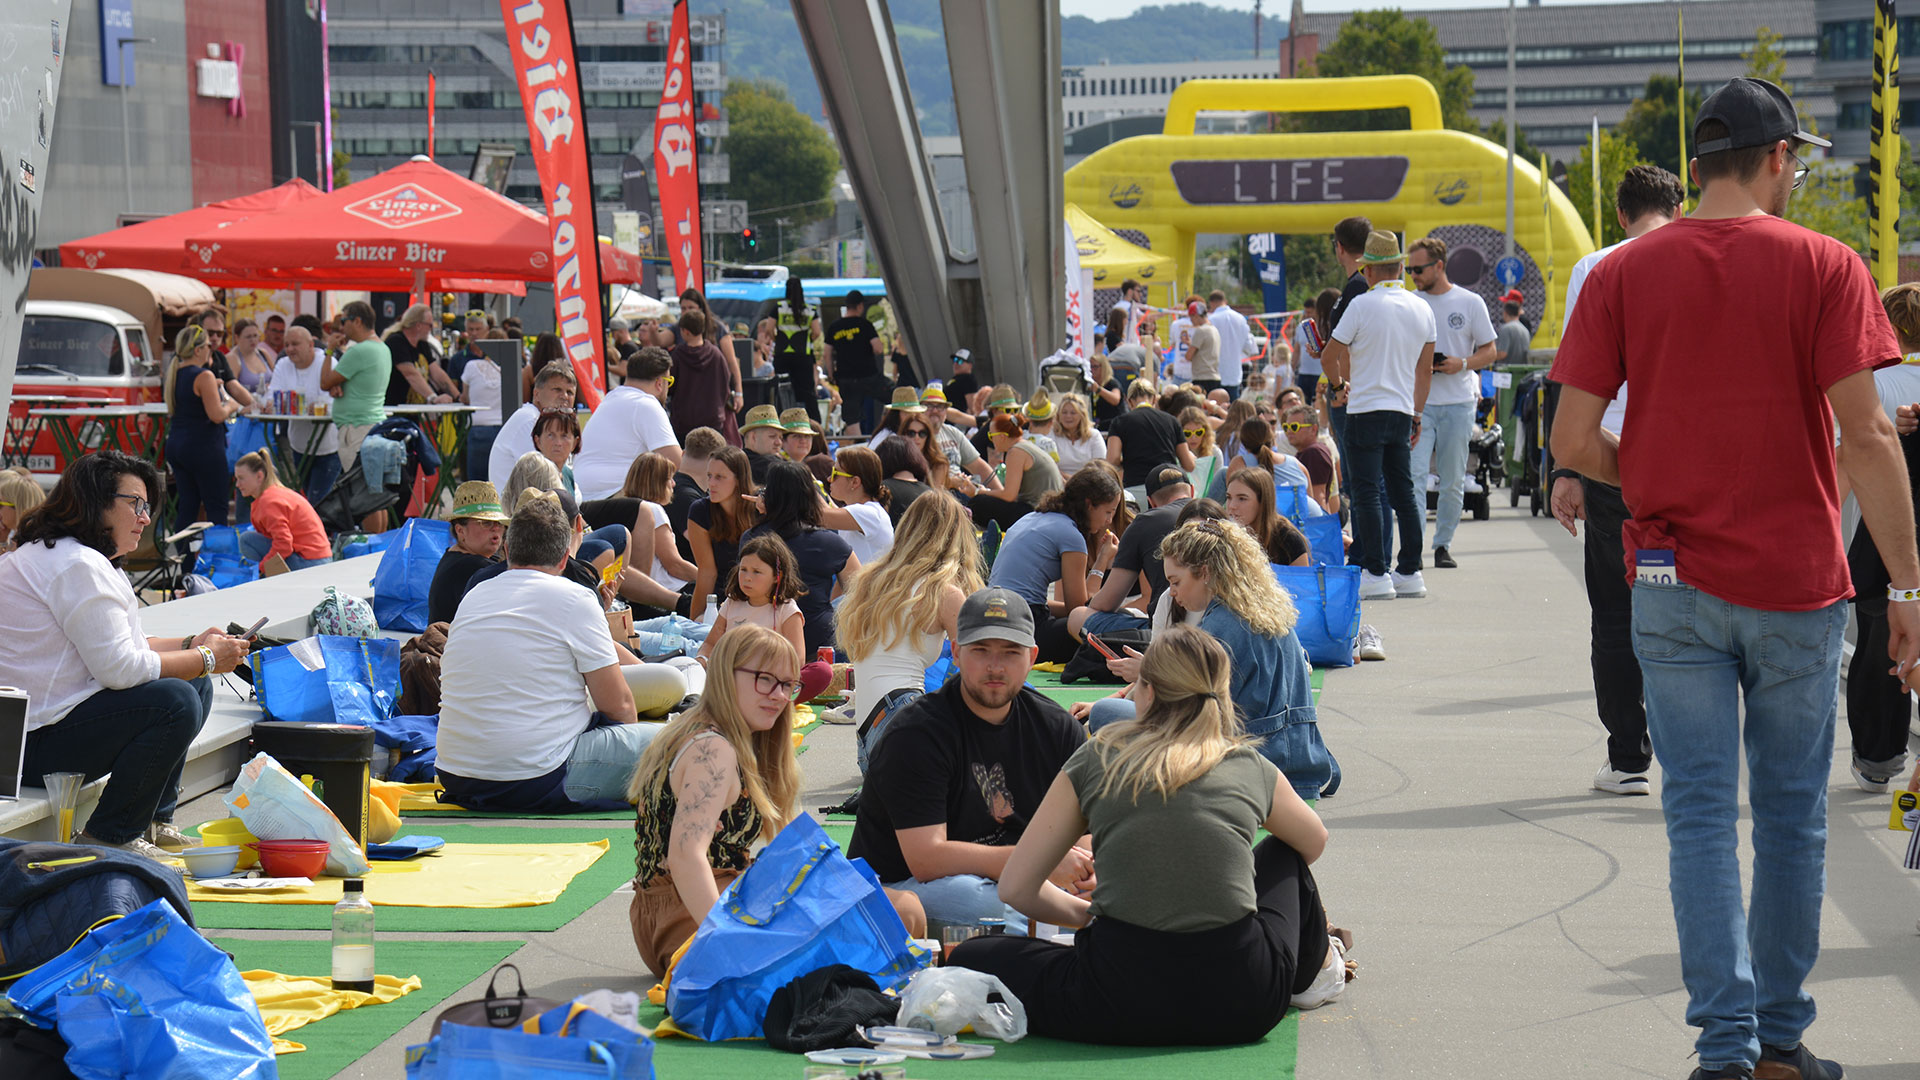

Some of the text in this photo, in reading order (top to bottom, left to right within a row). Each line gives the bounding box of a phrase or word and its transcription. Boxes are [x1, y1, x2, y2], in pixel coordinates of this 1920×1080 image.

[647, 20, 720, 42] ETCH
[1234, 161, 1344, 201] LIFE
[367, 199, 442, 213] Linzer
[335, 240, 447, 263] Linzer Bier
[8, 413, 48, 432] inzer
